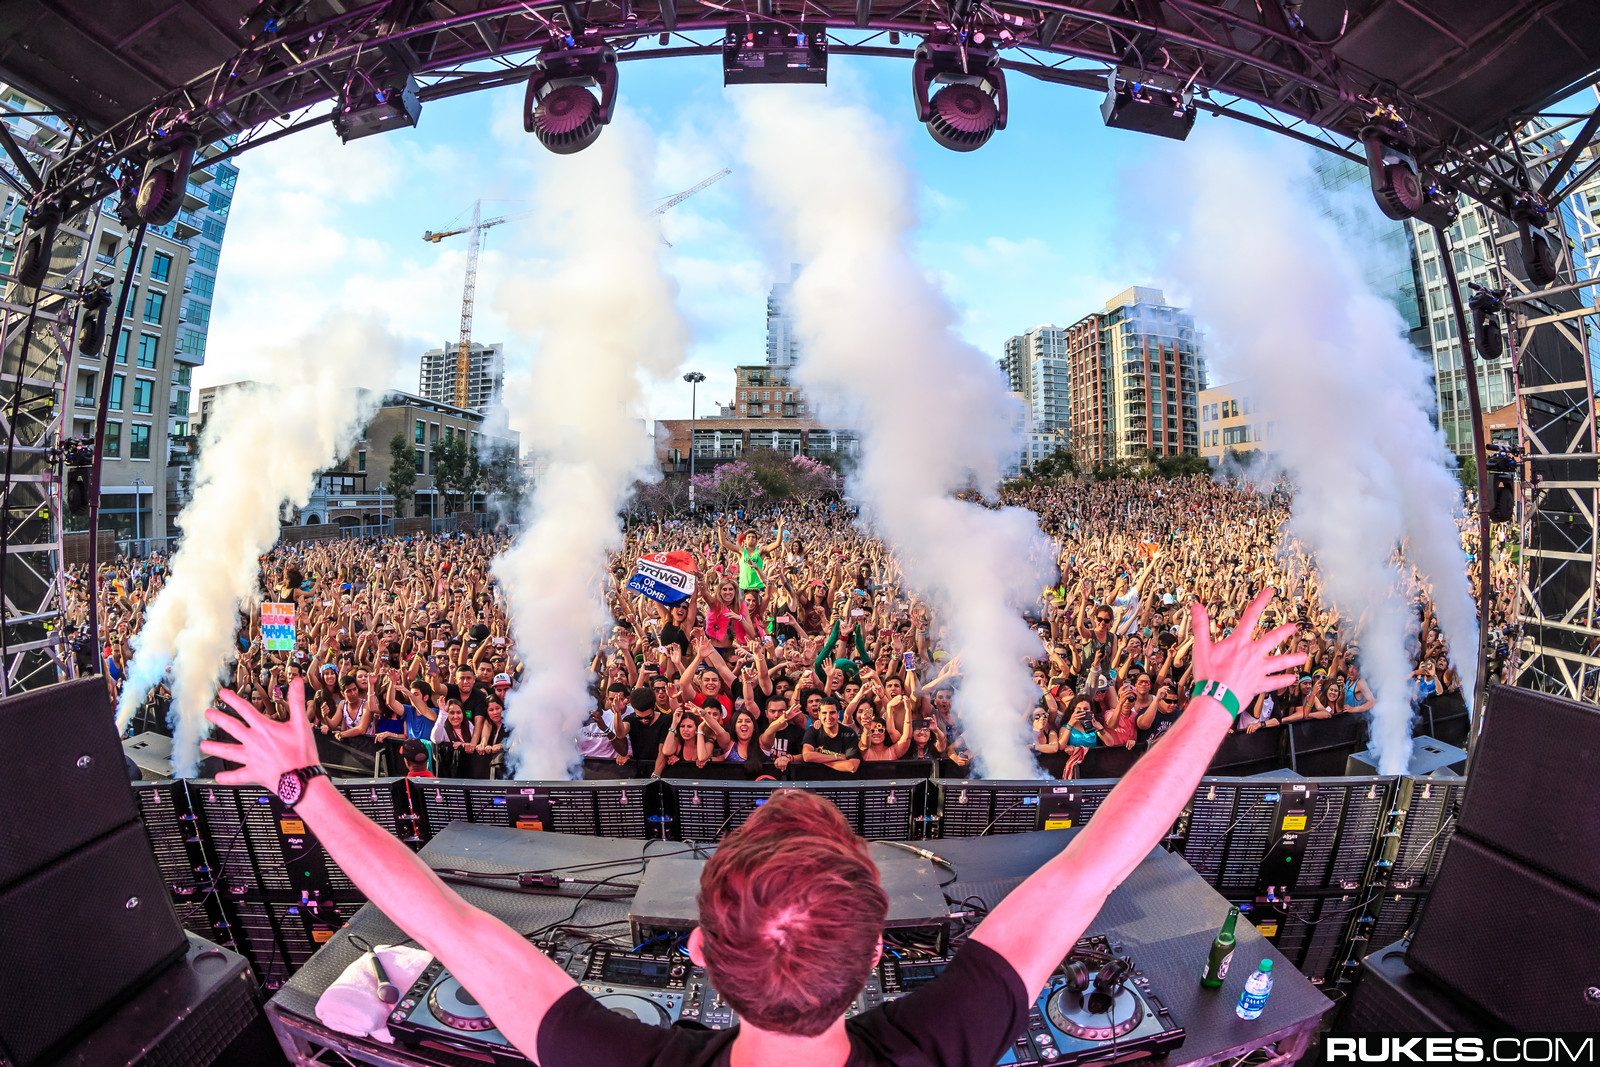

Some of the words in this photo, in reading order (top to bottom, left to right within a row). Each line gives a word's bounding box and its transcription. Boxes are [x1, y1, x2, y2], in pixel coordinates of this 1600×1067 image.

[654, 554, 667, 564] GO
[638, 560, 688, 589] ardwell
[644, 577, 655, 588] OR
[641, 584, 666, 602] HOME!
[275, 604, 294, 615] THE
[261, 615, 295, 626] REASON
[262, 625, 296, 640] HARDWELL
[267, 640, 277, 650] IS
[280, 638, 293, 650] #1
